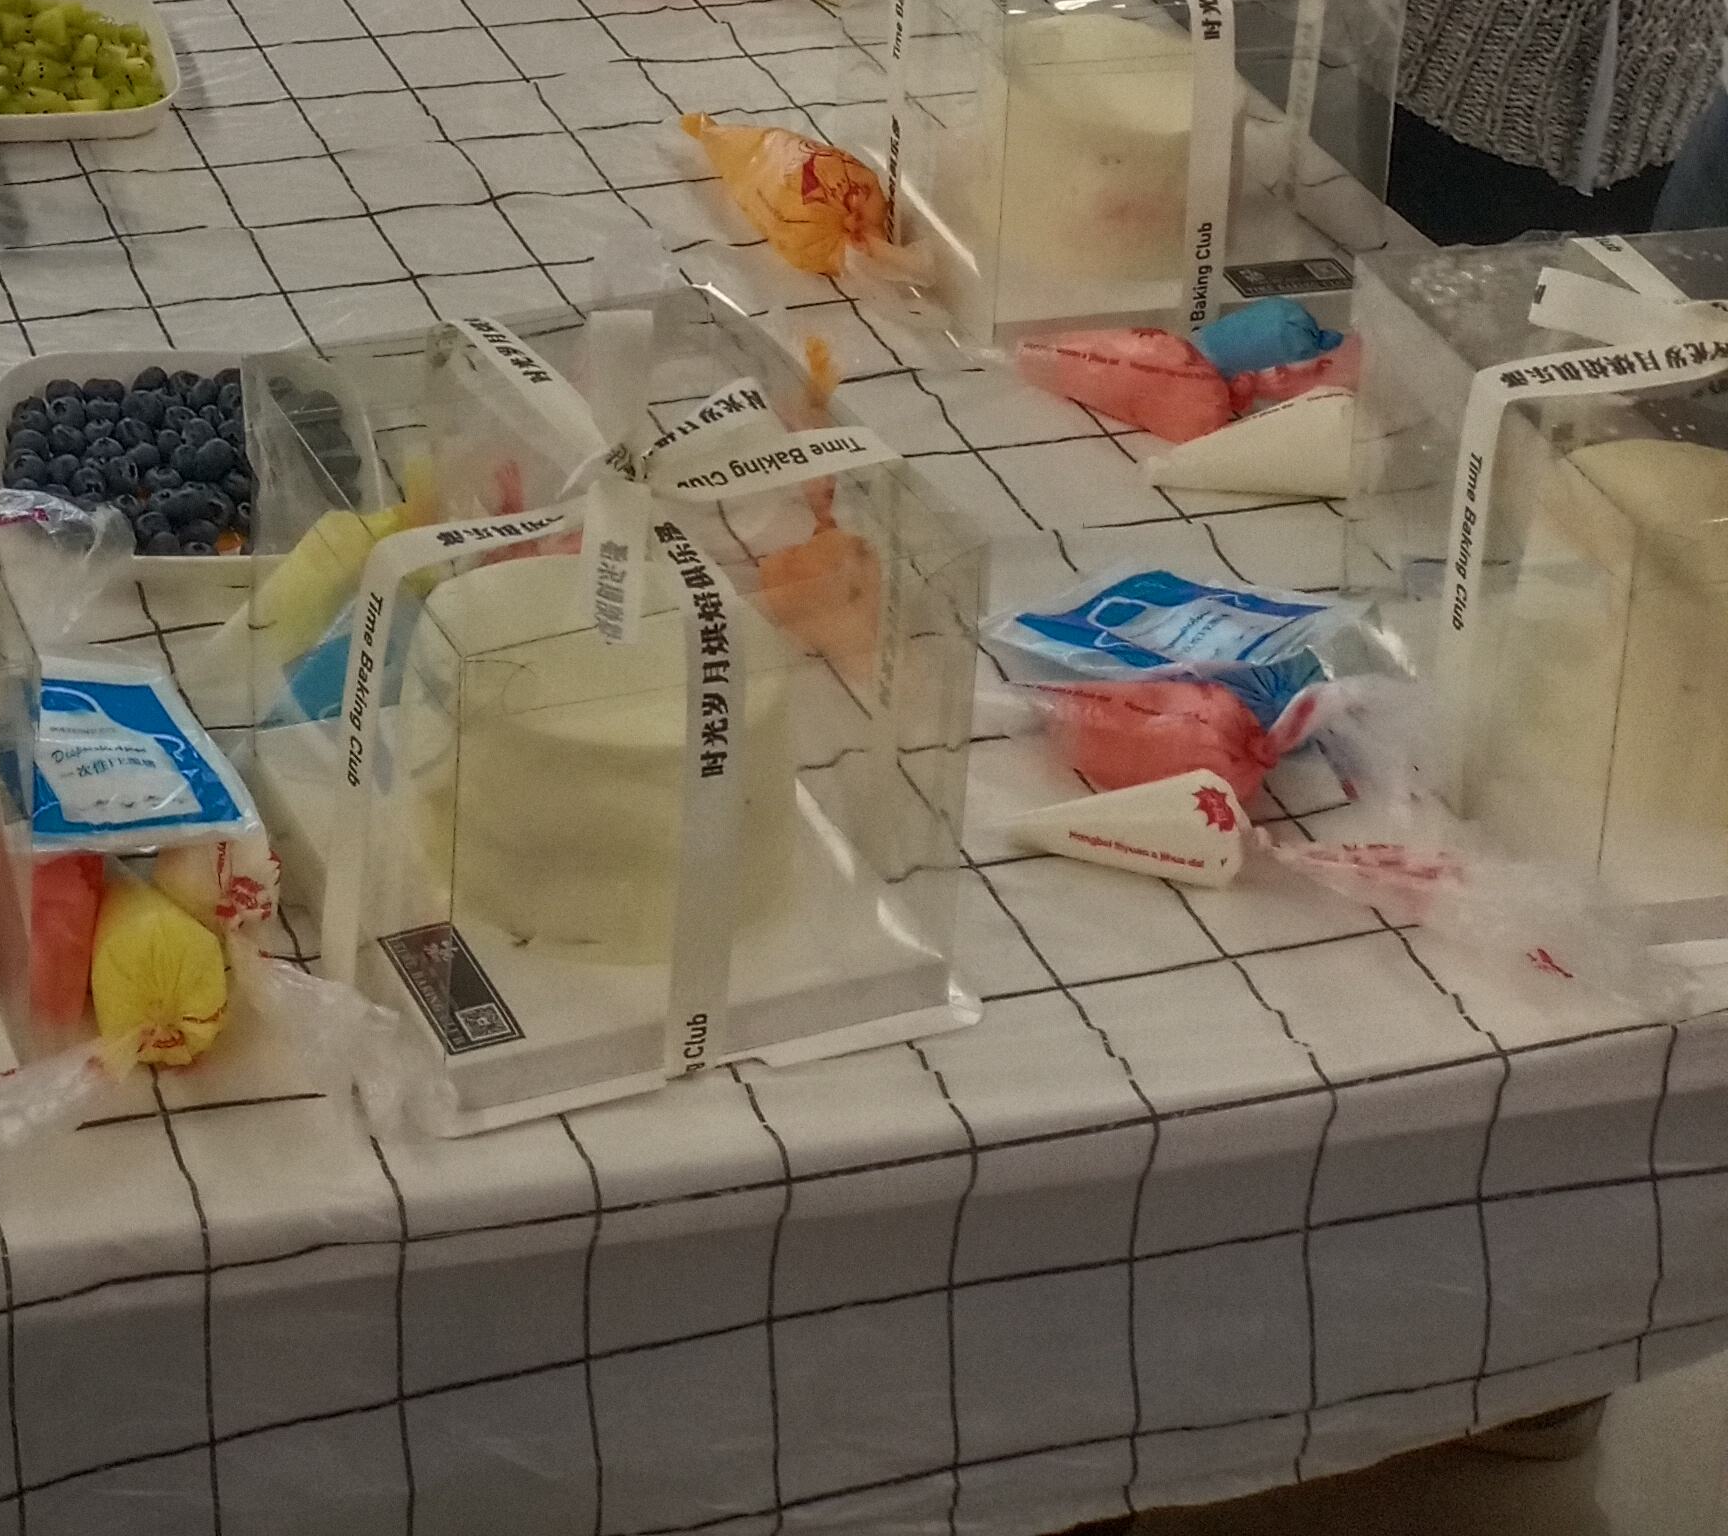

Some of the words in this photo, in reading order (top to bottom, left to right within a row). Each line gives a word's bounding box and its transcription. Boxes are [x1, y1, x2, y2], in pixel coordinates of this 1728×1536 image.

[892, 20, 905, 60] Time
[1195, 221, 1213, 262] Club
[1190, 265, 1212, 322] Baking
[728, 443, 809, 478] Baking
[809, 436, 868, 457] Time
[1464, 452, 1484, 505] Time
[1455, 508, 1478, 579] Baking
[363, 591, 384, 648] Time
[1451, 580, 1469, 632] Club
[654, 521, 732, 779] 时光岁月烘焙俱乐部
[349, 649, 374, 731] Baking
[337, 734, 364, 787] Club
[683, 1012, 709, 1060] Club
